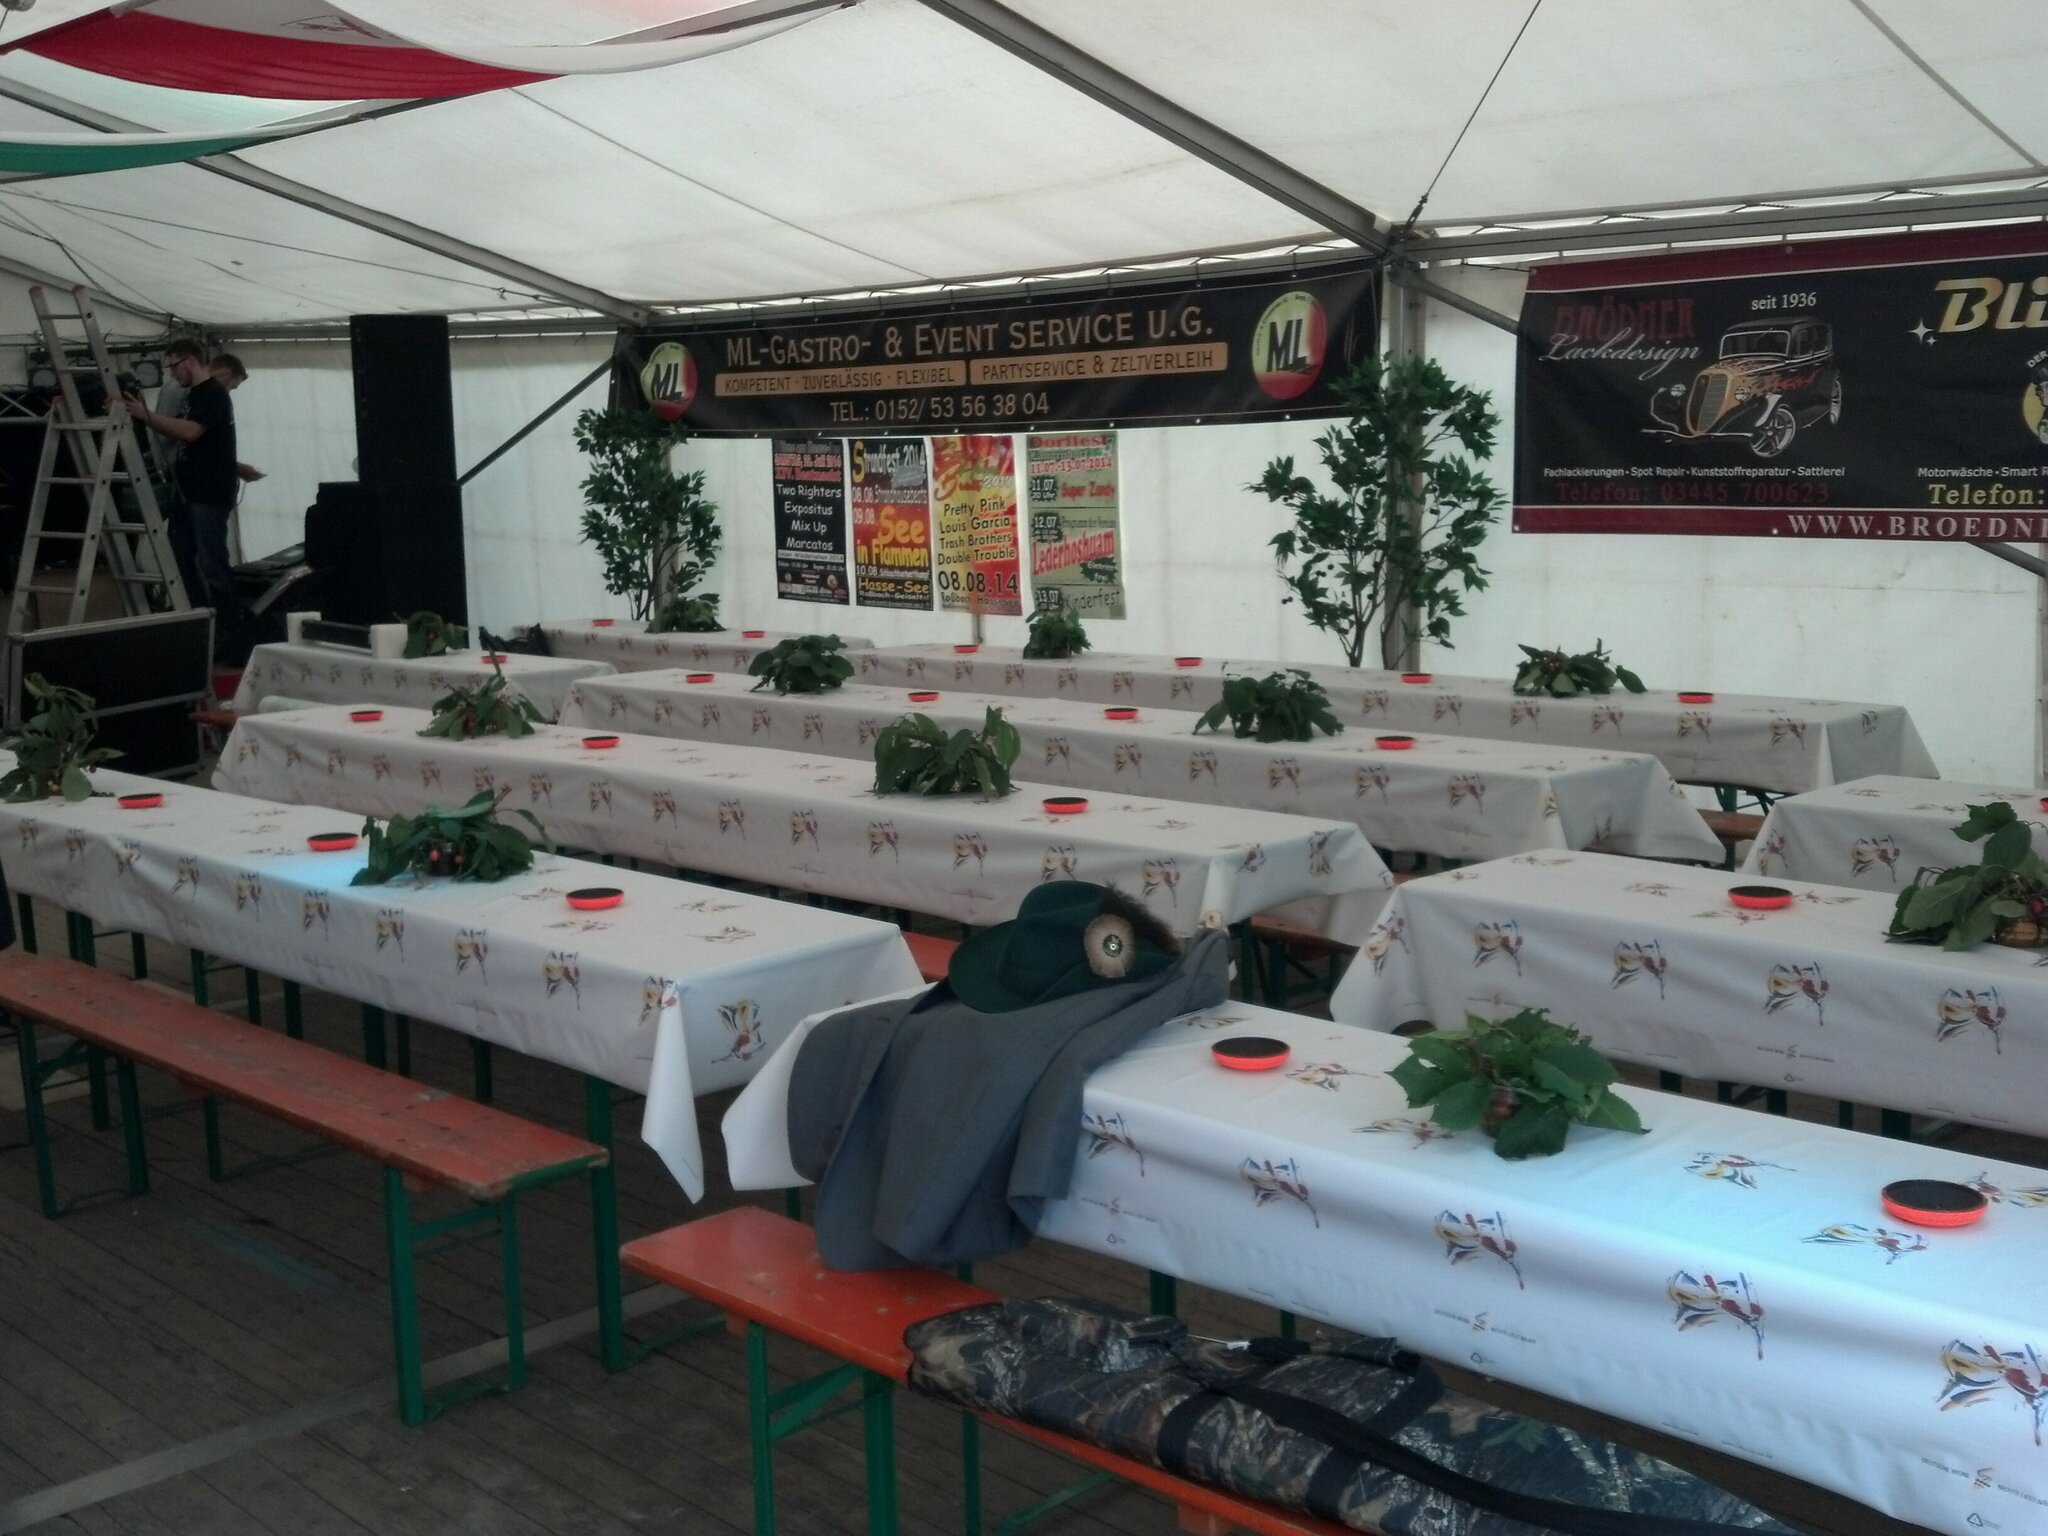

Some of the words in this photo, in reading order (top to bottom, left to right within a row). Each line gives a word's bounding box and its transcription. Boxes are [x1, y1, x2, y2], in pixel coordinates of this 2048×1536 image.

[1752, 295, 1777, 311] seit
[1781, 292, 1817, 309] 1936
[885, 327, 902, 357] &
[915, 322, 998, 356] EVENT
[1009, 312, 1133, 350] SERVICE
[1148, 306, 1213, 339] U.G.
[1267, 319, 1308, 372] ML
[1539, 327, 1699, 381] Lackdesign
[982, 359, 1084, 381] PARTYSERVICE
[1092, 355, 1105, 374] &
[1111, 350, 1214, 372] ZELTVERLEIH
[650, 363, 685, 401] ML
[724, 376, 791, 393] KOMPETENT
[803, 367, 882, 391] ZUVERLÄSSIG
[896, 367, 955, 386] FLEXIBEL
[830, 402, 869, 422] TEL.:
[876, 398, 924, 421] 0152/
[931, 399, 955, 418] 53
[962, 396, 986, 416] 56
[993, 395, 1016, 415] 38
[1022, 392, 1049, 413] 04
[903, 444, 926, 469] 2014
[1544, 467, 1624, 478] Fachlackierungen
[1630, 467, 1653, 478] Spot
[1656, 467, 1685, 478] Repair
[1691, 467, 1790, 478] Kunststoffreparatur
[1798, 467, 1845, 477] Sattlerei
[1918, 467, 1993, 478] Motorwäsche
[2000, 466, 2038, 477] Smart
[776, 484, 796, 496] Two
[798, 485, 842, 499] Righters
[1556, 484, 1649, 502] Telefon:
[1660, 483, 1729, 501] 03445
[1742, 483, 1831, 502] 700623
[1929, 484, 2044, 505] Telefon:
[784, 502, 833, 515] Expositus
[944, 502, 975, 517] Pretty
[980, 497, 1006, 512] Pink
[791, 521, 810, 532] Mix
[813, 521, 827, 535] Up
[878, 505, 925, 544] See
[940, 520, 967, 534] Louis
[971, 516, 1010, 531] Garcia
[786, 537, 833, 550] Marcatos
[940, 537, 965, 550] Trash
[968, 533, 1012, 547] Brothers
[857, 540, 868, 564] in
[872, 540, 929, 567] Flammen
[938, 552, 971, 566] Double
[973, 549, 1015, 562] Trouble
[858, 577, 929, 594] Hasse-See
[938, 570, 1018, 595] 08.08.14
